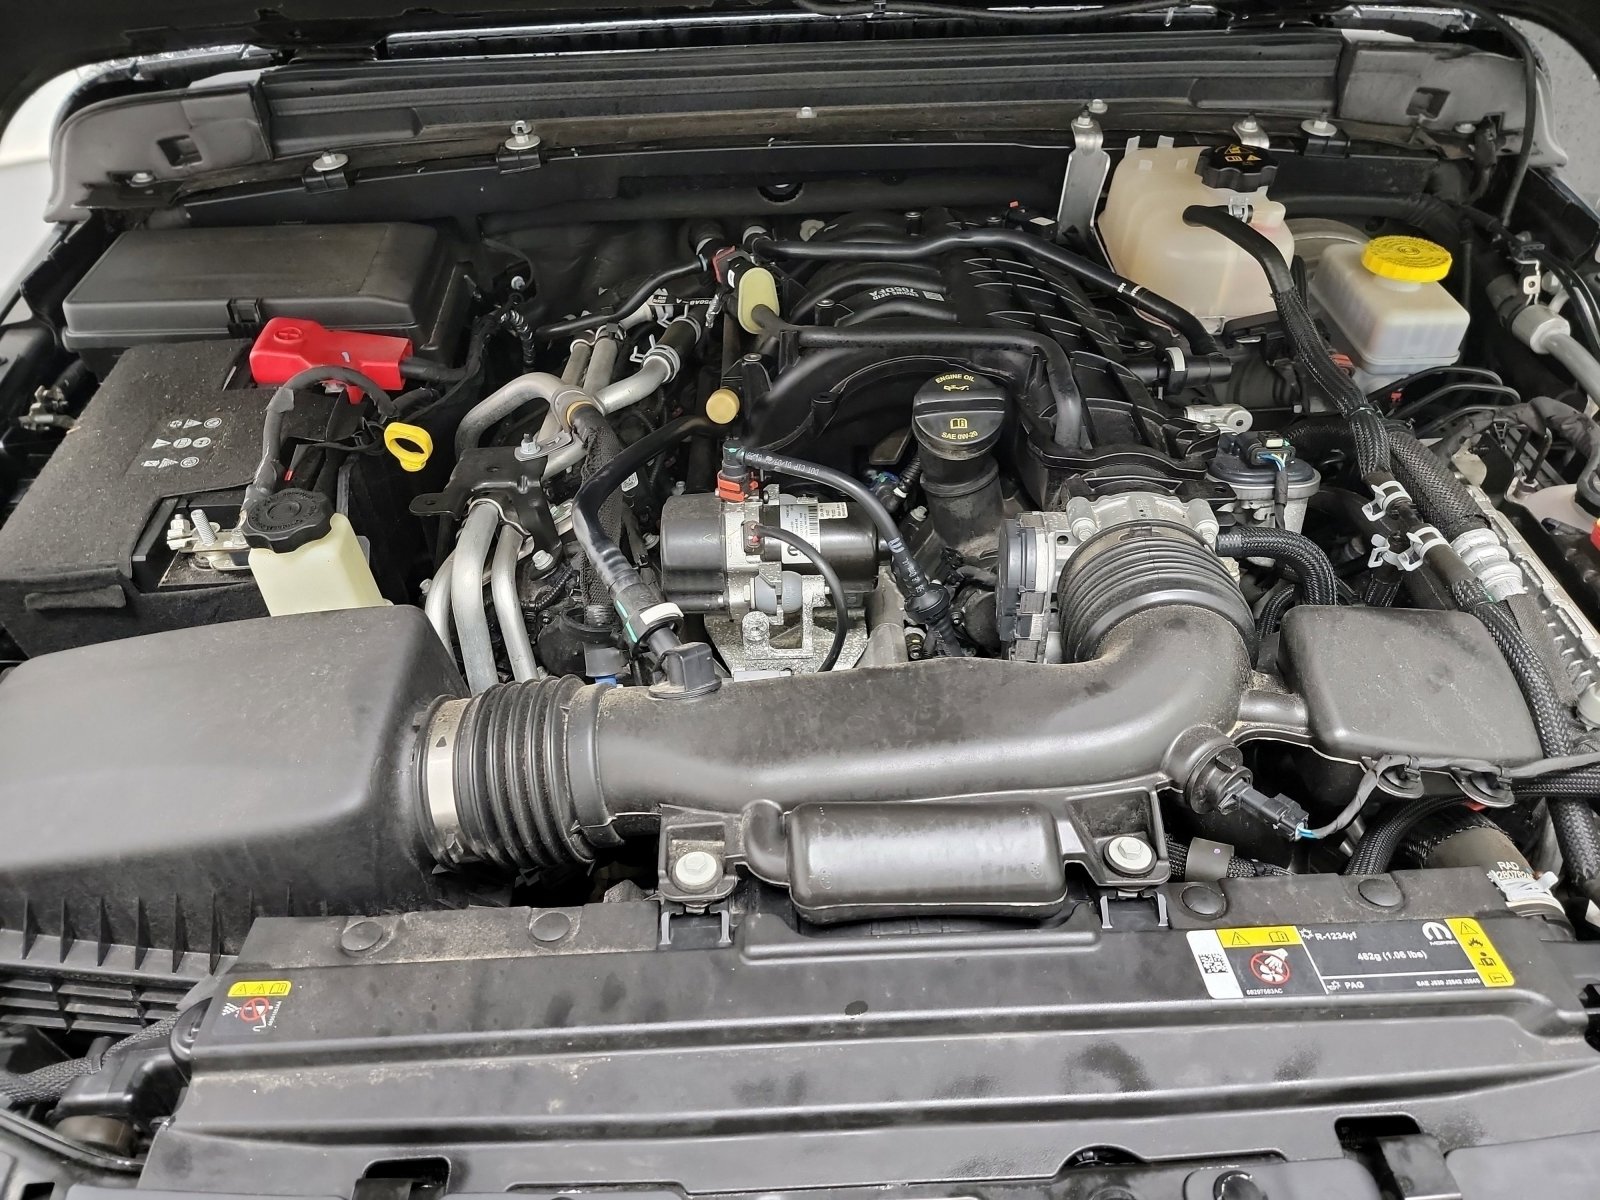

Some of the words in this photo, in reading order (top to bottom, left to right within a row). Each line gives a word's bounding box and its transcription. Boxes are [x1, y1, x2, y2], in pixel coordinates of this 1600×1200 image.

[935, 373, 962, 384] ENGINE
[963, 374, 975, 382] OIL
[941, 431, 957, 440] SAE
[957, 430, 978, 440] 0W-20
[1496, 861, 1520, 871] RAD
[1314, 931, 1358, 941] R-1234yf
[1344, 981, 1365, 990] PAG
